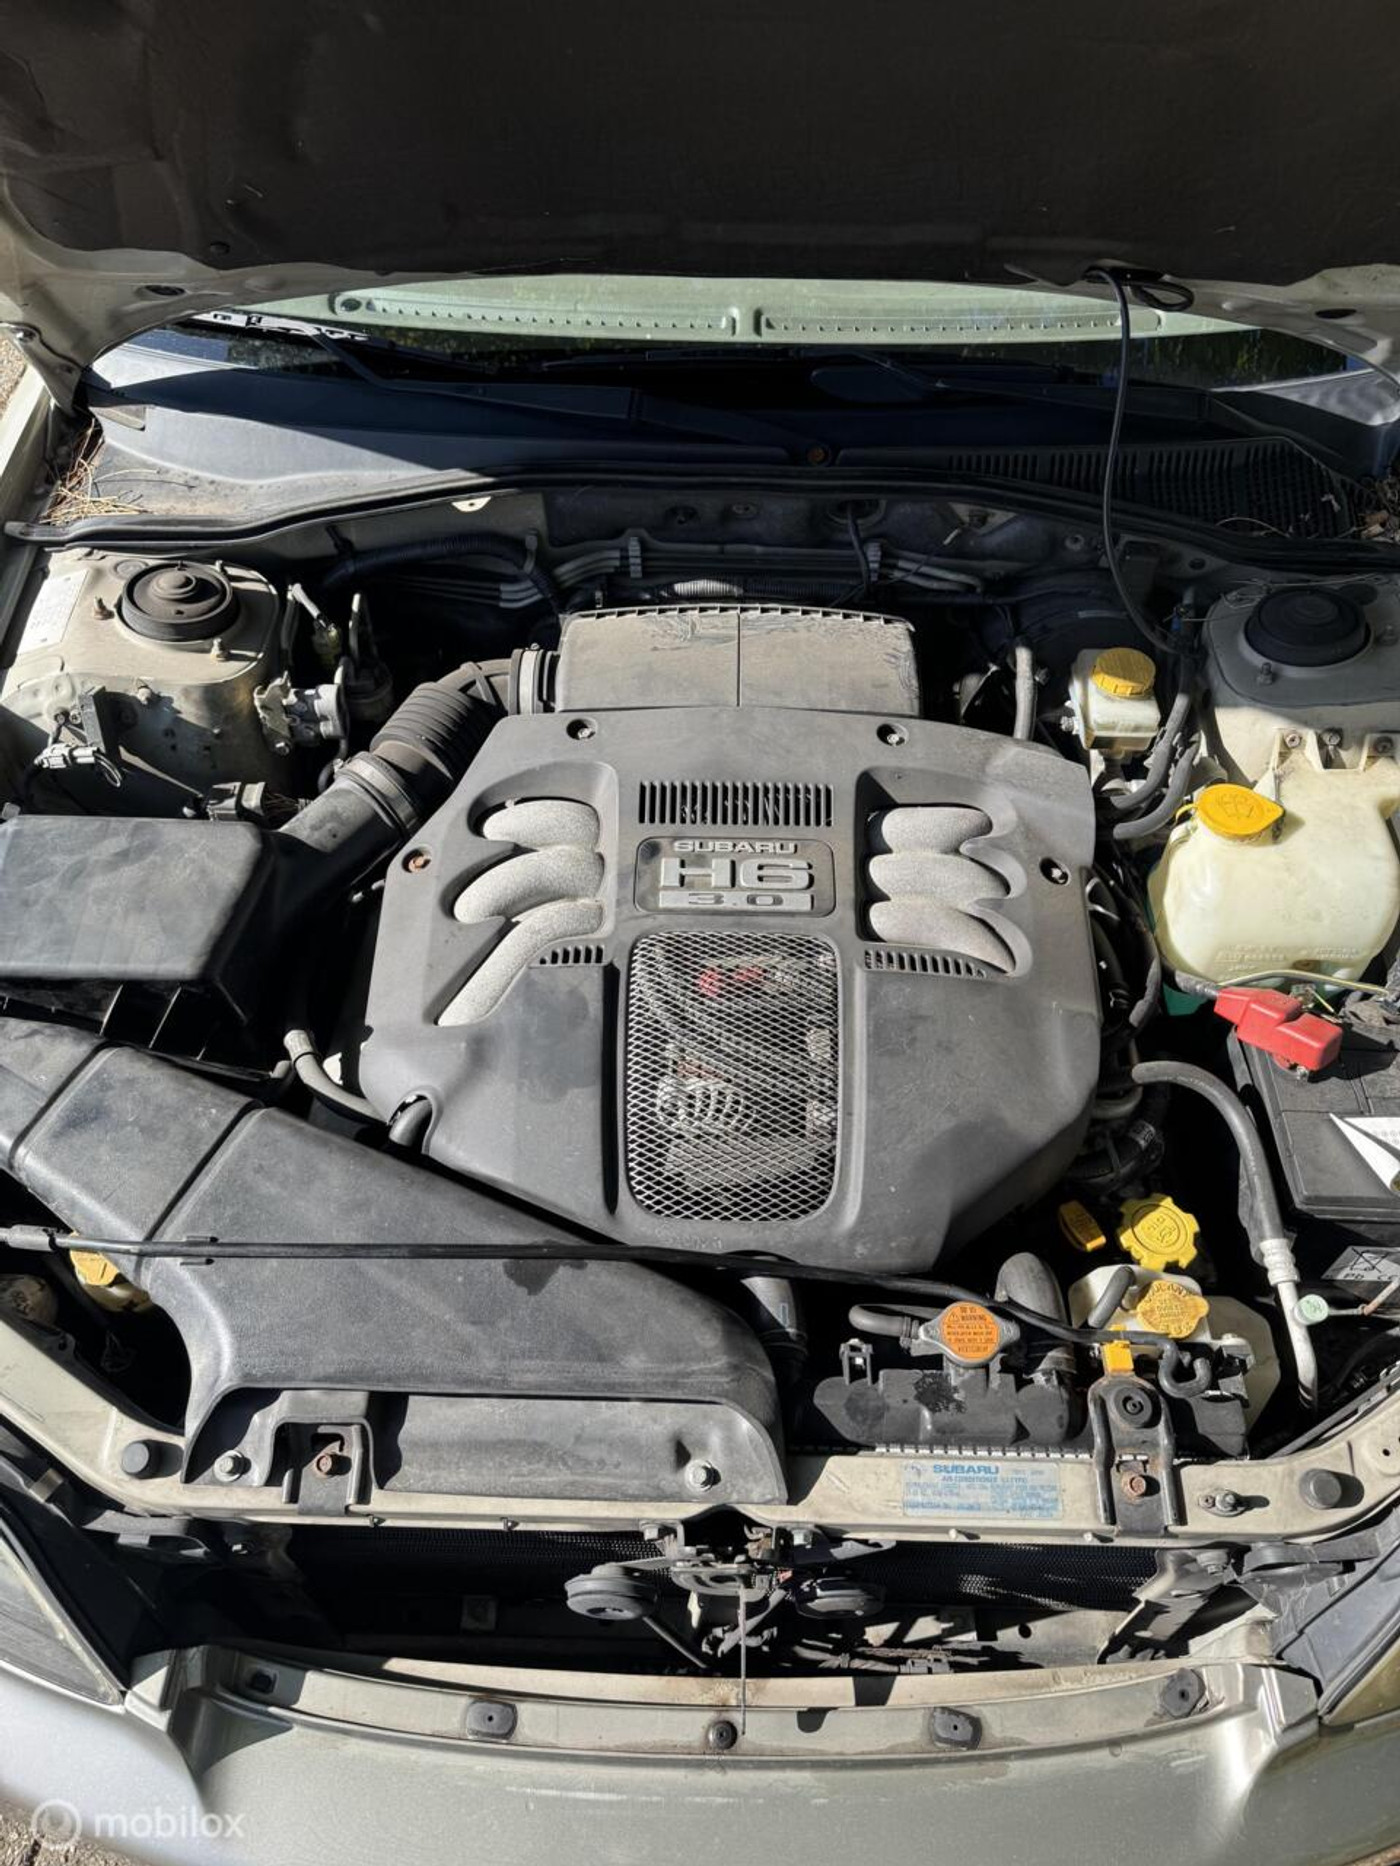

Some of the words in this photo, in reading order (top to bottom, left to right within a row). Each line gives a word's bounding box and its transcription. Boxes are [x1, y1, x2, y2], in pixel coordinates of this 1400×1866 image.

[673, 841, 797, 854] SUBARU
[660, 857, 814, 890] H6
[688, 892, 784, 908] 3.0
[933, 1464, 999, 1475] SUBARU
